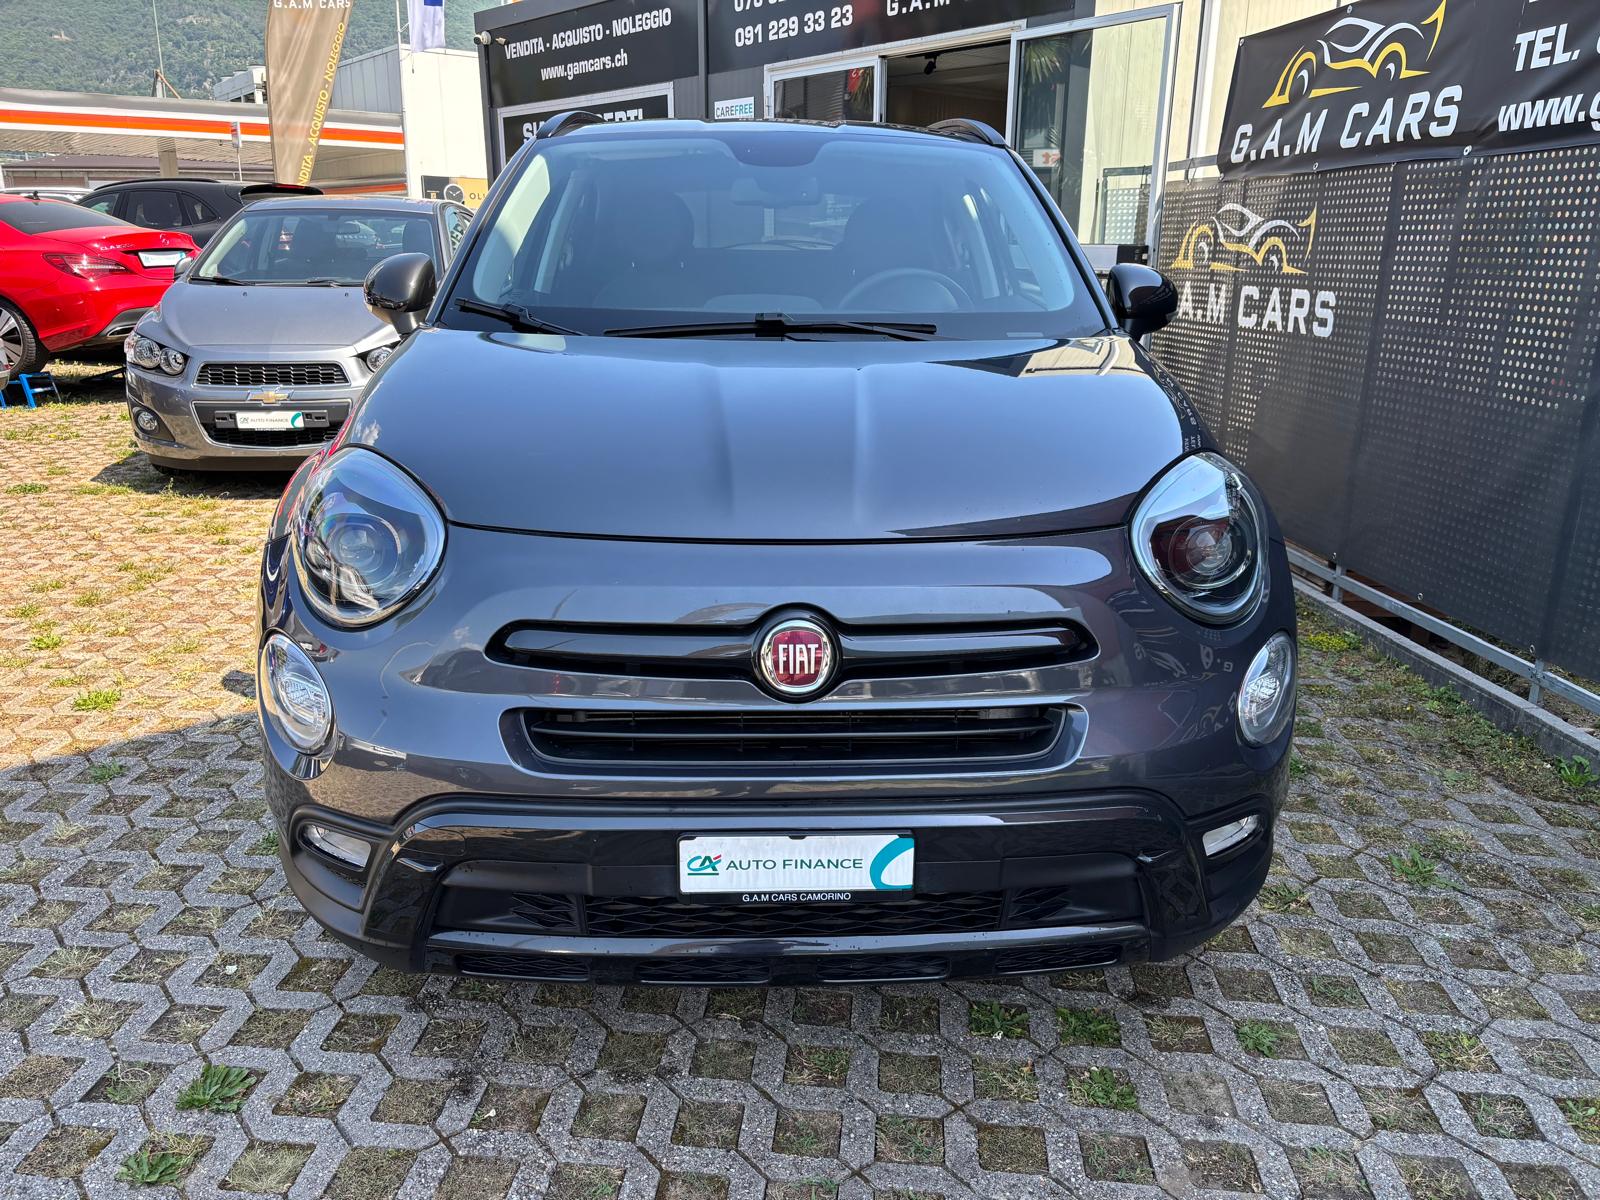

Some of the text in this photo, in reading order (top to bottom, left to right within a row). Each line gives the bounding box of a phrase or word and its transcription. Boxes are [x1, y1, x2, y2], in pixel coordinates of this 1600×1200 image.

[504, 37, 545, 60] VENDITA
[552, 24, 603, 51] ACQUISTO
[612, 7, 672, 36] NOLEGGIO
[735, 4, 853, 47] 091 229 33 23
[541, 48, 628, 81] www.gamcars.ch
[1515, 23, 1580, 72] TEL.
[308, 91, 328, 146] ACQUISTO
[324, 22, 345, 82] NOLEGGIO
[715, 103, 753, 118] CAREFREE
[1230, 85, 1462, 164] G.A.M CARS
[1237, 285, 1336, 338] CARS
[778, 643, 819, 675] FIAT
[726, 859, 777, 871] AUTO
[783, 858, 863, 870] FINANCE
[742, 892, 851, 902] G.A.M CARS CAMORINO
